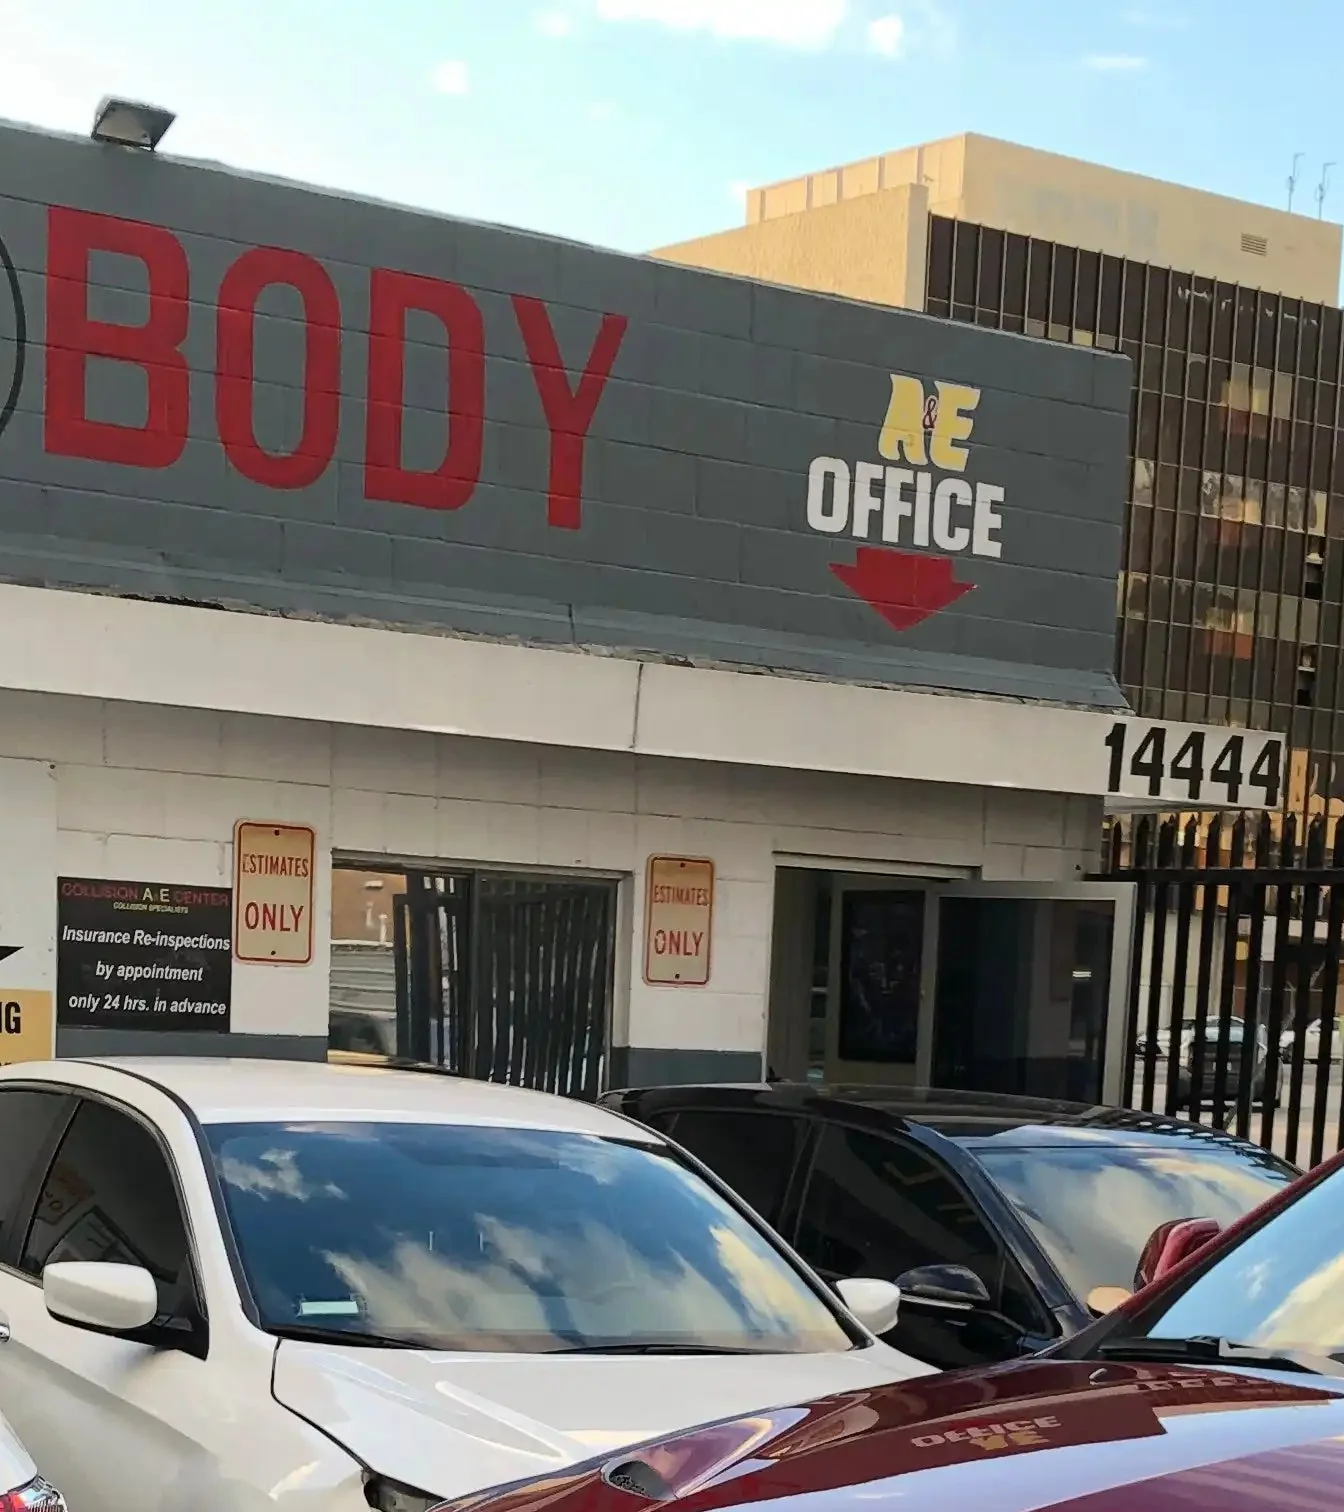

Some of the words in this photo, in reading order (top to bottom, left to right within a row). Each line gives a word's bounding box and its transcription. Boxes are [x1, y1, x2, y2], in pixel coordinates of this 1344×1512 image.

[44, 205, 628, 530] BODY
[807, 456, 1005, 558] OFFICE
[1104, 722, 1282, 807] 14444
[242, 853, 309, 878] ESTIMATES
[62, 883, 138, 900] COLLISION
[174, 891, 229, 907] CENTER
[113, 901, 148, 911] COLLISION
[653, 884, 709, 907] ESTIMATES
[245, 901, 304, 932] ONLY
[62, 925, 131, 945] Insurance
[133, 929, 231, 951] Re-inspections
[655, 929, 703, 957] ONLY
[95, 960, 115, 980] by
[116, 963, 204, 982] appointment
[68, 993, 100, 1013] only
[102, 994, 121, 1010] 24
[123, 995, 150, 1012] hrs.
[153, 995, 167, 1012] in
[169, 997, 227, 1015] advance
